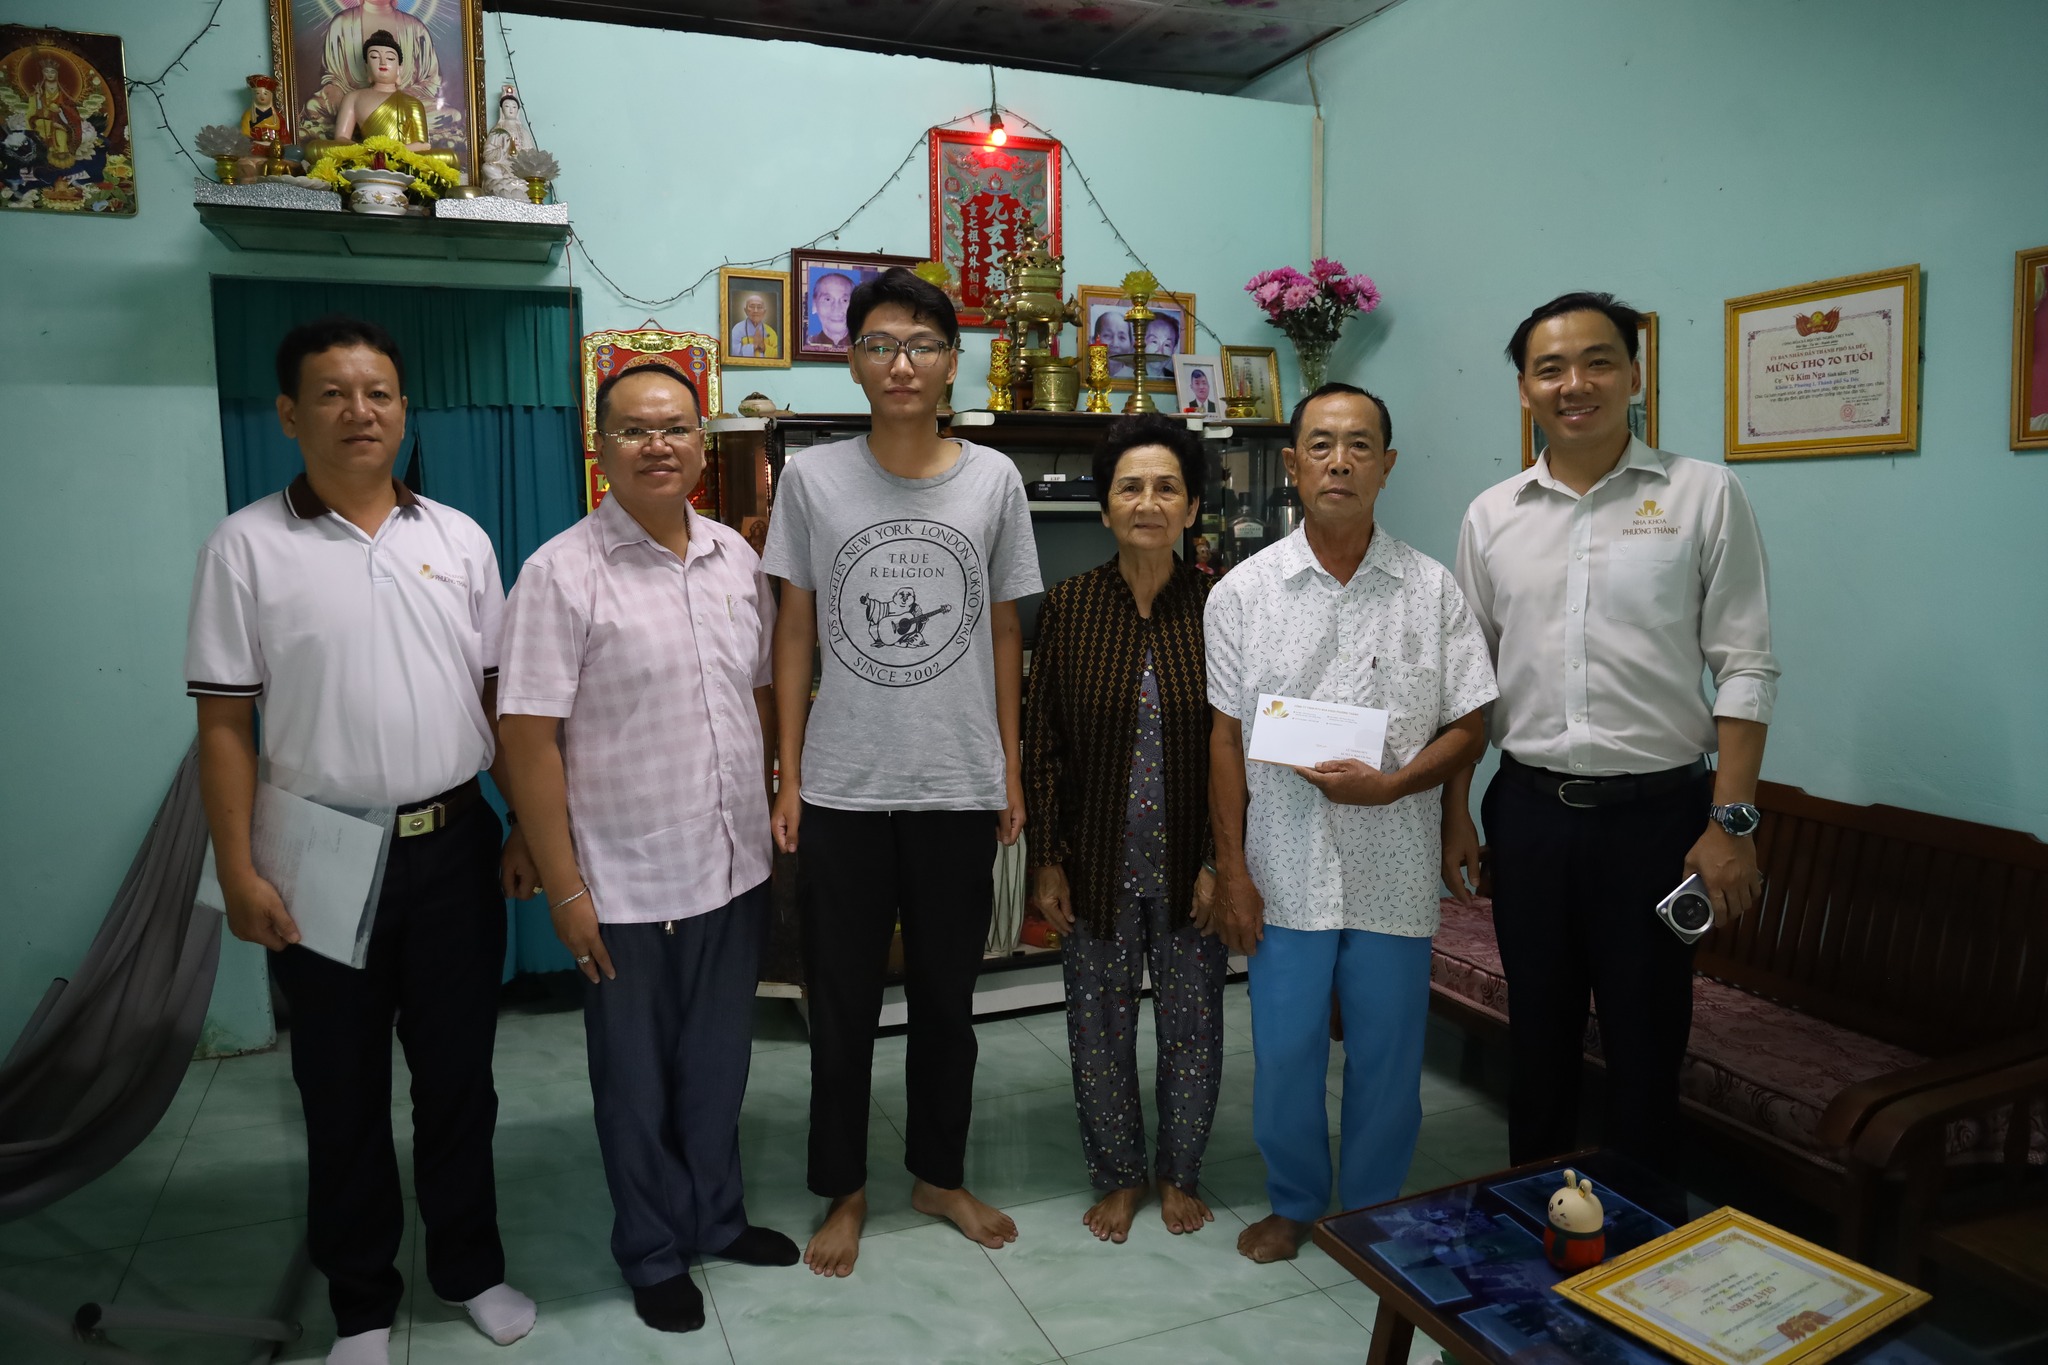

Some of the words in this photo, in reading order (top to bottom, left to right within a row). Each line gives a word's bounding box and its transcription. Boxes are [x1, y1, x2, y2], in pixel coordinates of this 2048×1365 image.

[1801, 358, 1826, 369] THỌ
[1828, 356, 1842, 365] 70
[1844, 348, 1873, 363] TUỔI
[1796, 373, 1811, 381] Kim
[1812, 371, 1826, 380] Nga
[875, 523, 914, 540] YORK
[921, 524, 972, 561] LONDON
[1653, 525, 1679, 535] THÀNH
[844, 533, 871, 560] NEW
[889, 553, 930, 564] TRUE
[870, 567, 945, 578] RELIGION
[830, 561, 847, 616] ANGELES
[967, 562, 981, 609] TOKYO
[830, 619, 844, 644] LOS
[955, 613, 974, 648] PARIS
[853, 656, 897, 682] SINCE
[904, 662, 941, 683] 2002
